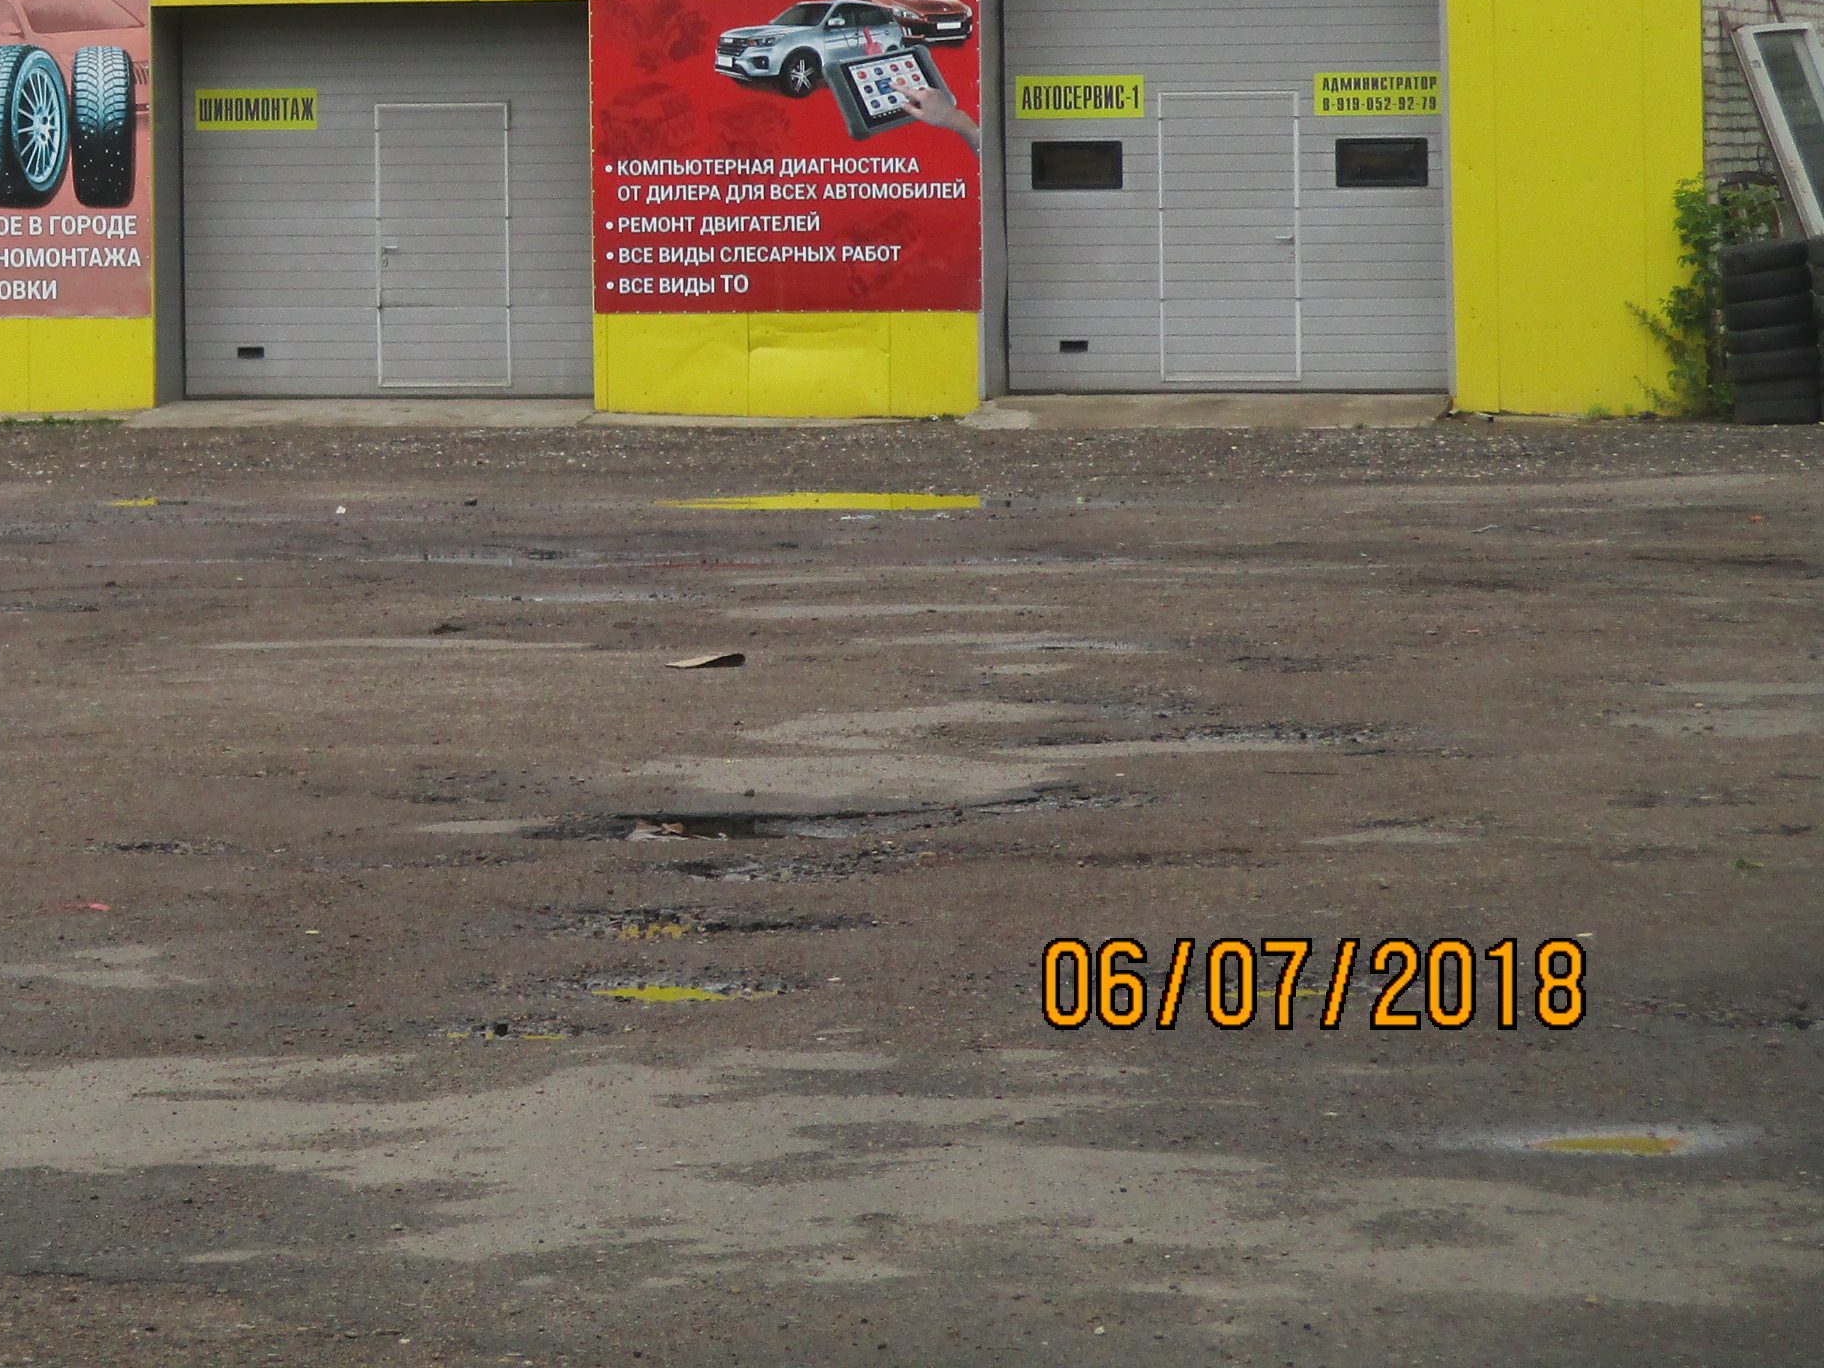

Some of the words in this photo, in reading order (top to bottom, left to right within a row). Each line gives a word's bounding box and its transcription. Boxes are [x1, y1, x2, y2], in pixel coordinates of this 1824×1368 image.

[1021, 84, 1139, 110] АВТОСЕРВИС-1
[1322, 76, 1437, 93] АДМИНИСТРАТОР
[199, 97, 314, 122] ШИНОМОНТАЖ
[617, 158, 775, 176] КОМПЬЮТЕРНАЯ
[779, 157, 920, 178] ДИАГНОСТИКА
[617, 185, 642, 202] ОТ
[646, 184, 721, 205] ДИЛЕРА
[725, 184, 765, 204] ДЛЯ
[769, 183, 818, 200] ВСЕХ
[822, 178, 966, 200] АВТОМОБИЛЕЙ
[29, 216, 43, 236] В
[49, 215, 138, 240] ГОРОДЕ
[618, 215, 695, 234] РЕМОНТ
[699, 210, 821, 236] ДВИГАТЕЛЕЙ
[618, 247, 654, 264] ВСЕ
[659, 246, 715, 267] ВИДЫ
[719, 245, 837, 264] СЛЕСАРНЫХ
[842, 245, 901, 263] РАБОТ
[618, 278, 654, 295] ВСЕ
[659, 277, 715, 297] ВИДЫ
[720, 274, 749, 294] ТО
